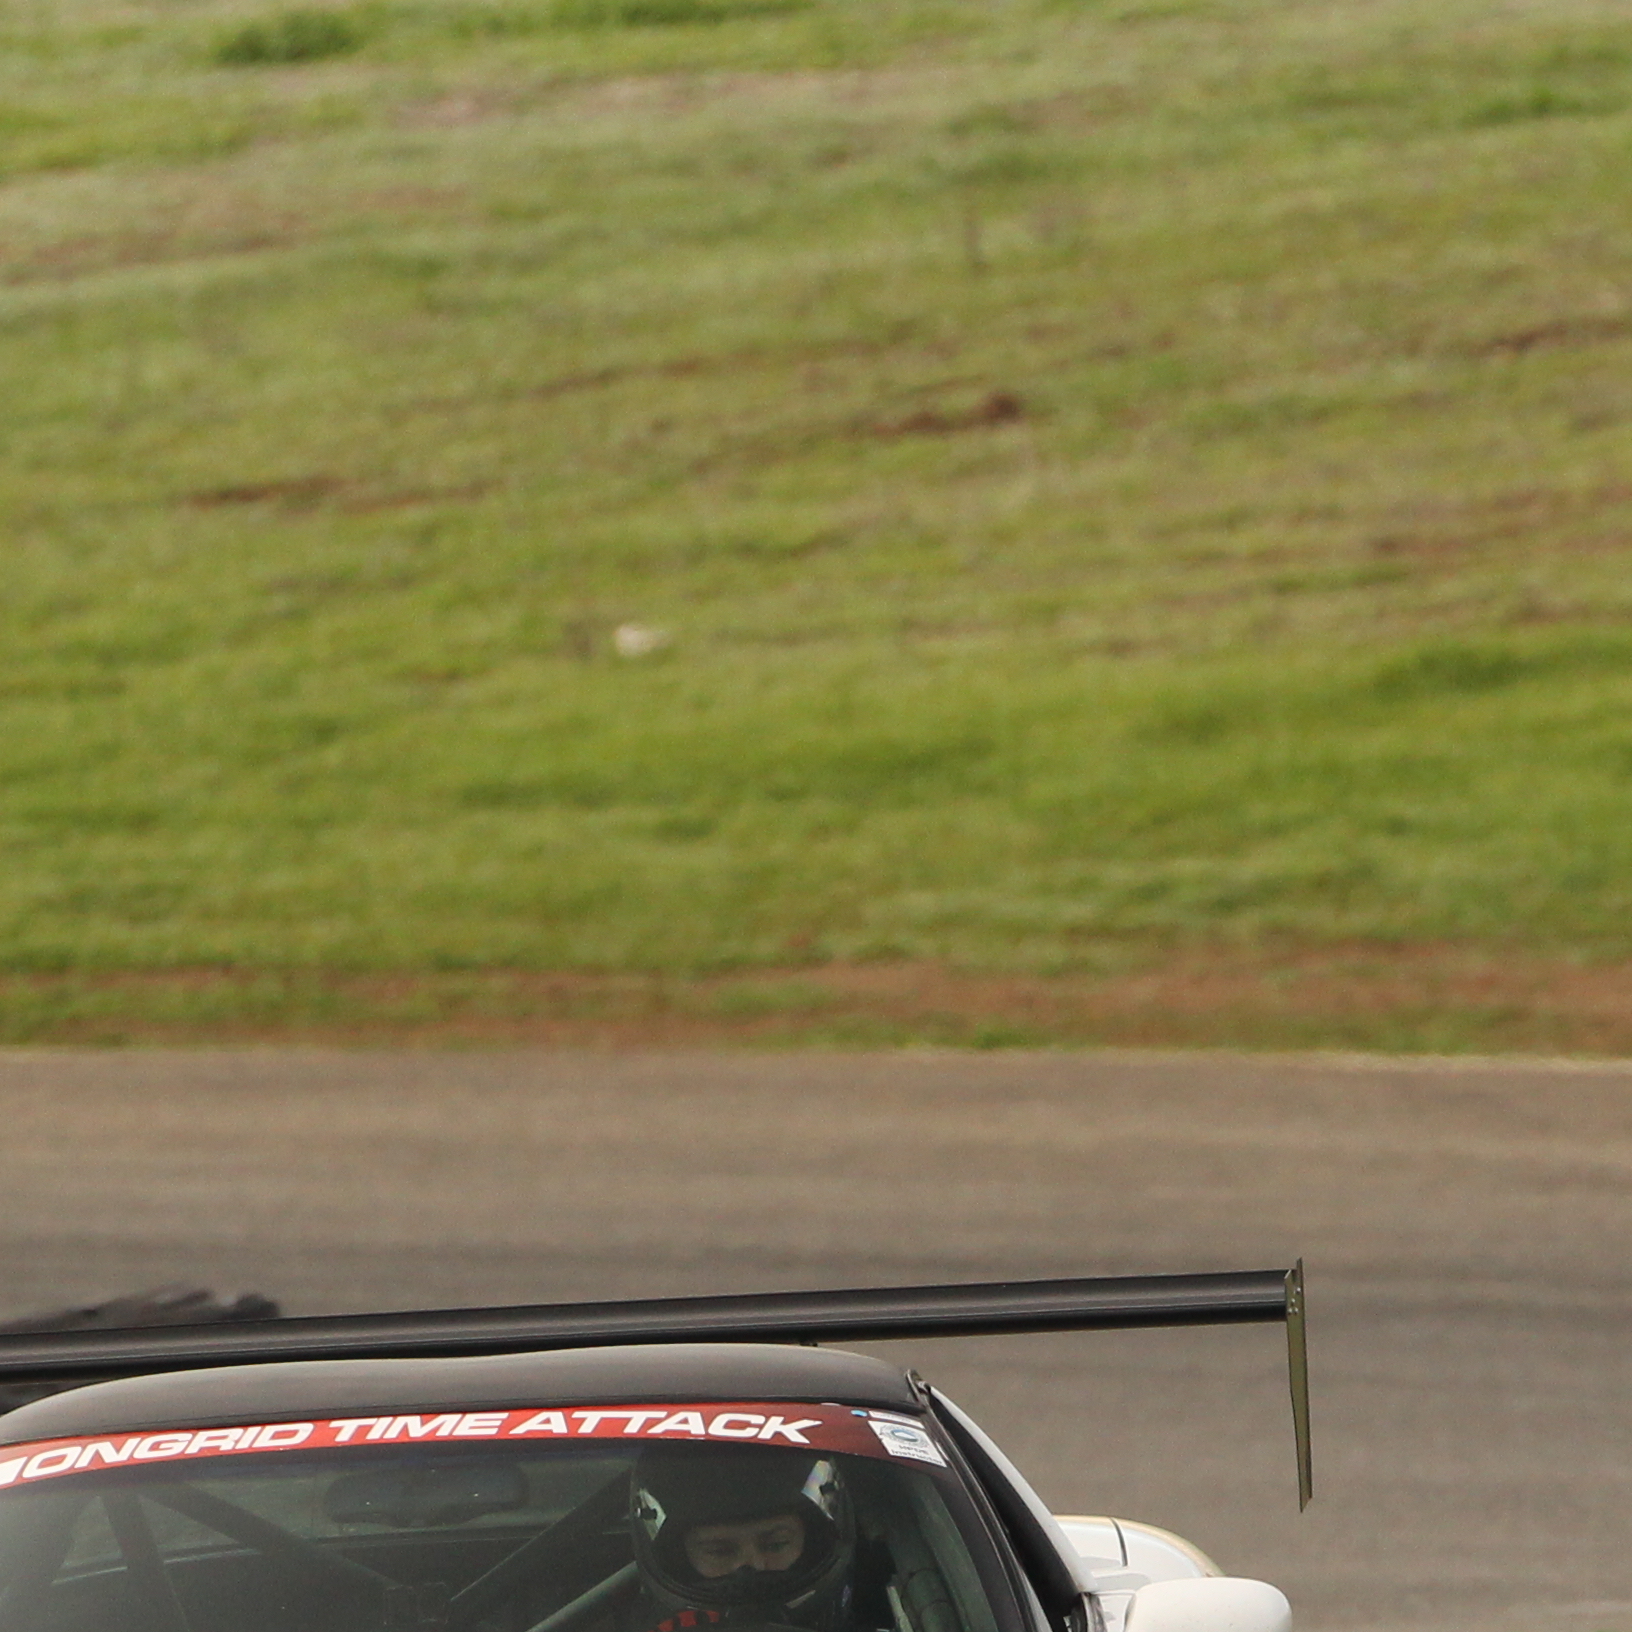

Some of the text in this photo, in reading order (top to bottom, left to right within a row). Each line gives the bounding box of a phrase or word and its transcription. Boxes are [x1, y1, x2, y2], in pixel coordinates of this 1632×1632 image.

[21, 1411, 823, 1478] ONGRID TIME ATTACK
